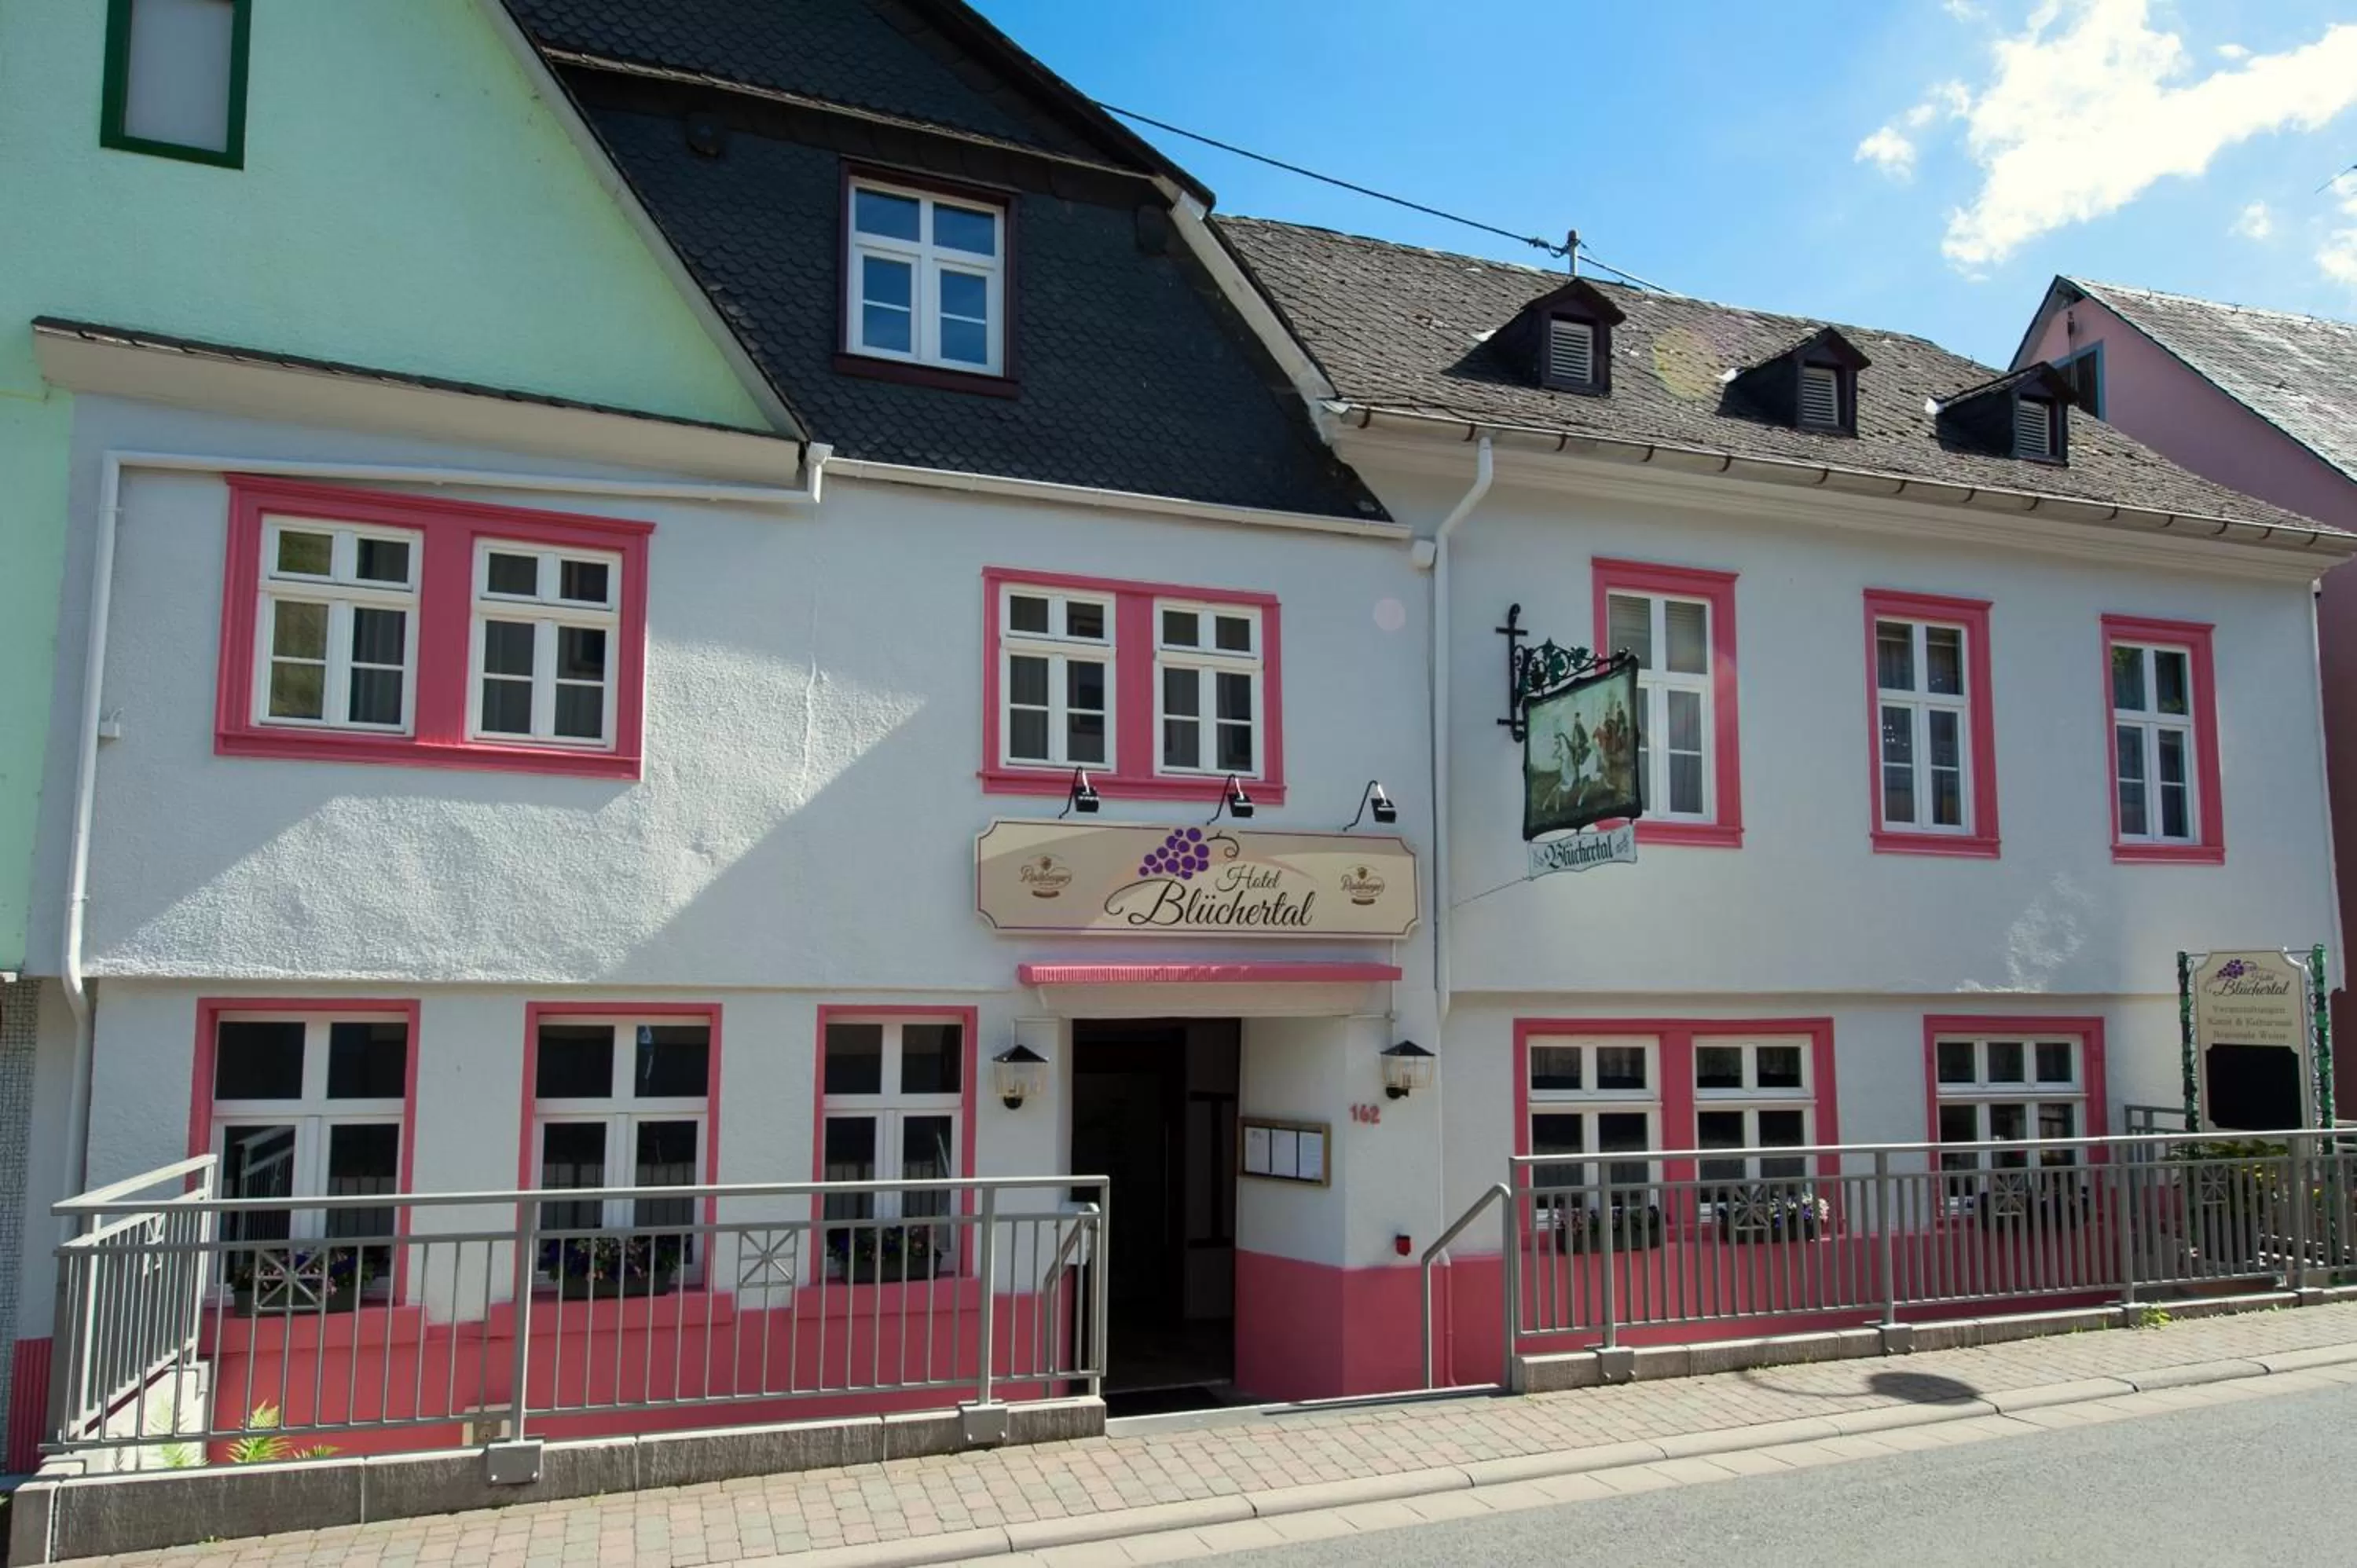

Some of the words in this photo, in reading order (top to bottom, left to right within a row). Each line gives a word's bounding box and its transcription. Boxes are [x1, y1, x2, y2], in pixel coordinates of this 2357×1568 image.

[1215, 863, 1282, 892] Hotel
[1104, 877, 1317, 925] Blüchertal
[1349, 1103, 1380, 1124] 162
